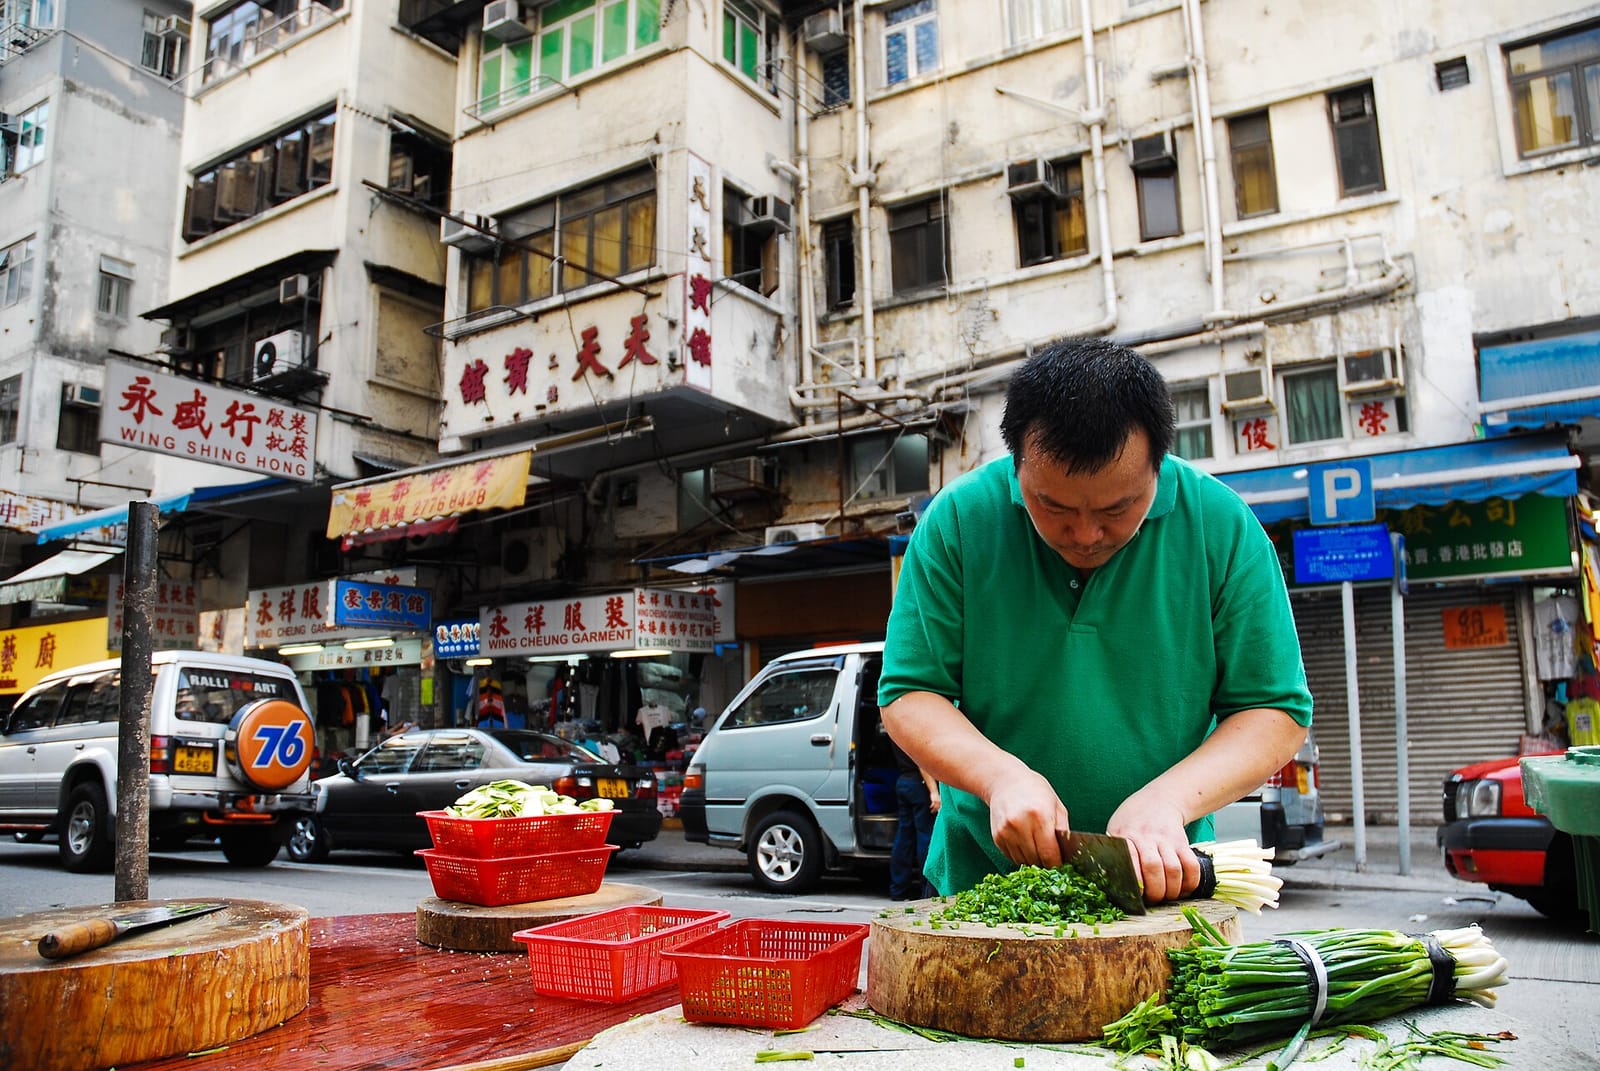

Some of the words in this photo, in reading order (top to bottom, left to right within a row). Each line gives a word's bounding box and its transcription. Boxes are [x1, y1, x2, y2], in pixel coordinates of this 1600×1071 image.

[1241, 417, 1276, 450] 俊
[1358, 402, 1390, 436] 榮
[121, 427, 175, 450] WING
[187, 441, 247, 464] SHING
[257, 455, 306, 477] HONG
[1322, 468, 1362, 518] P
[277, 625, 306, 637] CHEUNG
[489, 596, 629, 639] 永祥服裝
[488, 638, 517, 649] WING
[520, 634, 568, 647] CHEUNG
[571, 628, 633, 644] GARMENT
[189, 674, 229, 689] RALLI
[254, 682, 277, 694] ART
[251, 720, 306, 768] 76
